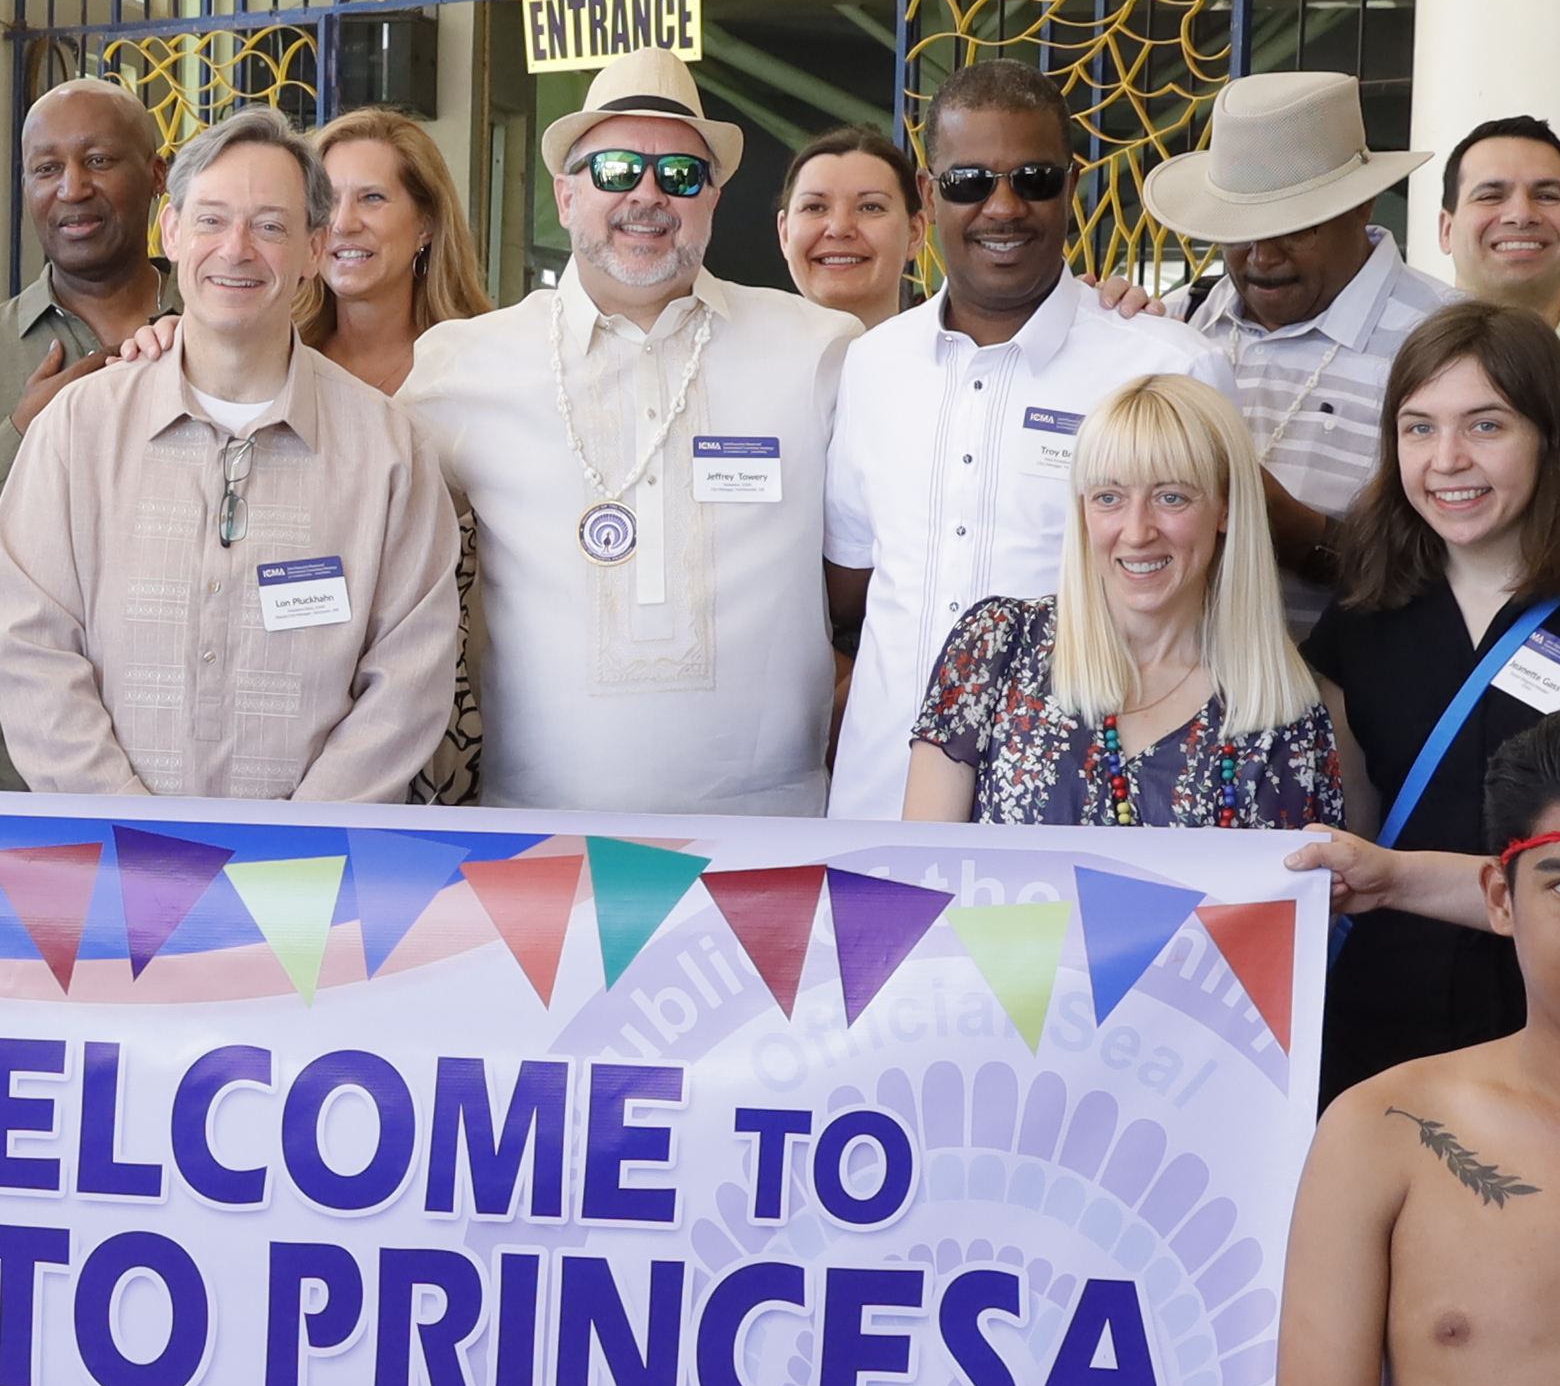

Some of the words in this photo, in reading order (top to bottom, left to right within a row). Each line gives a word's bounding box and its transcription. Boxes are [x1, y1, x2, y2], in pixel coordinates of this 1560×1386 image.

[1029, 412, 1055, 424] ICMA
[698, 441, 721, 451] ICMA
[1041, 446, 1060, 457] Troy
[706, 473, 734, 482] Jeffrey
[738, 473, 768, 482] Towery
[262, 567, 286, 578] ICMA
[275, 599, 291, 608] Lon
[292, 594, 335, 605] Pluckhahn
[735, 1107, 913, 1225] TO
